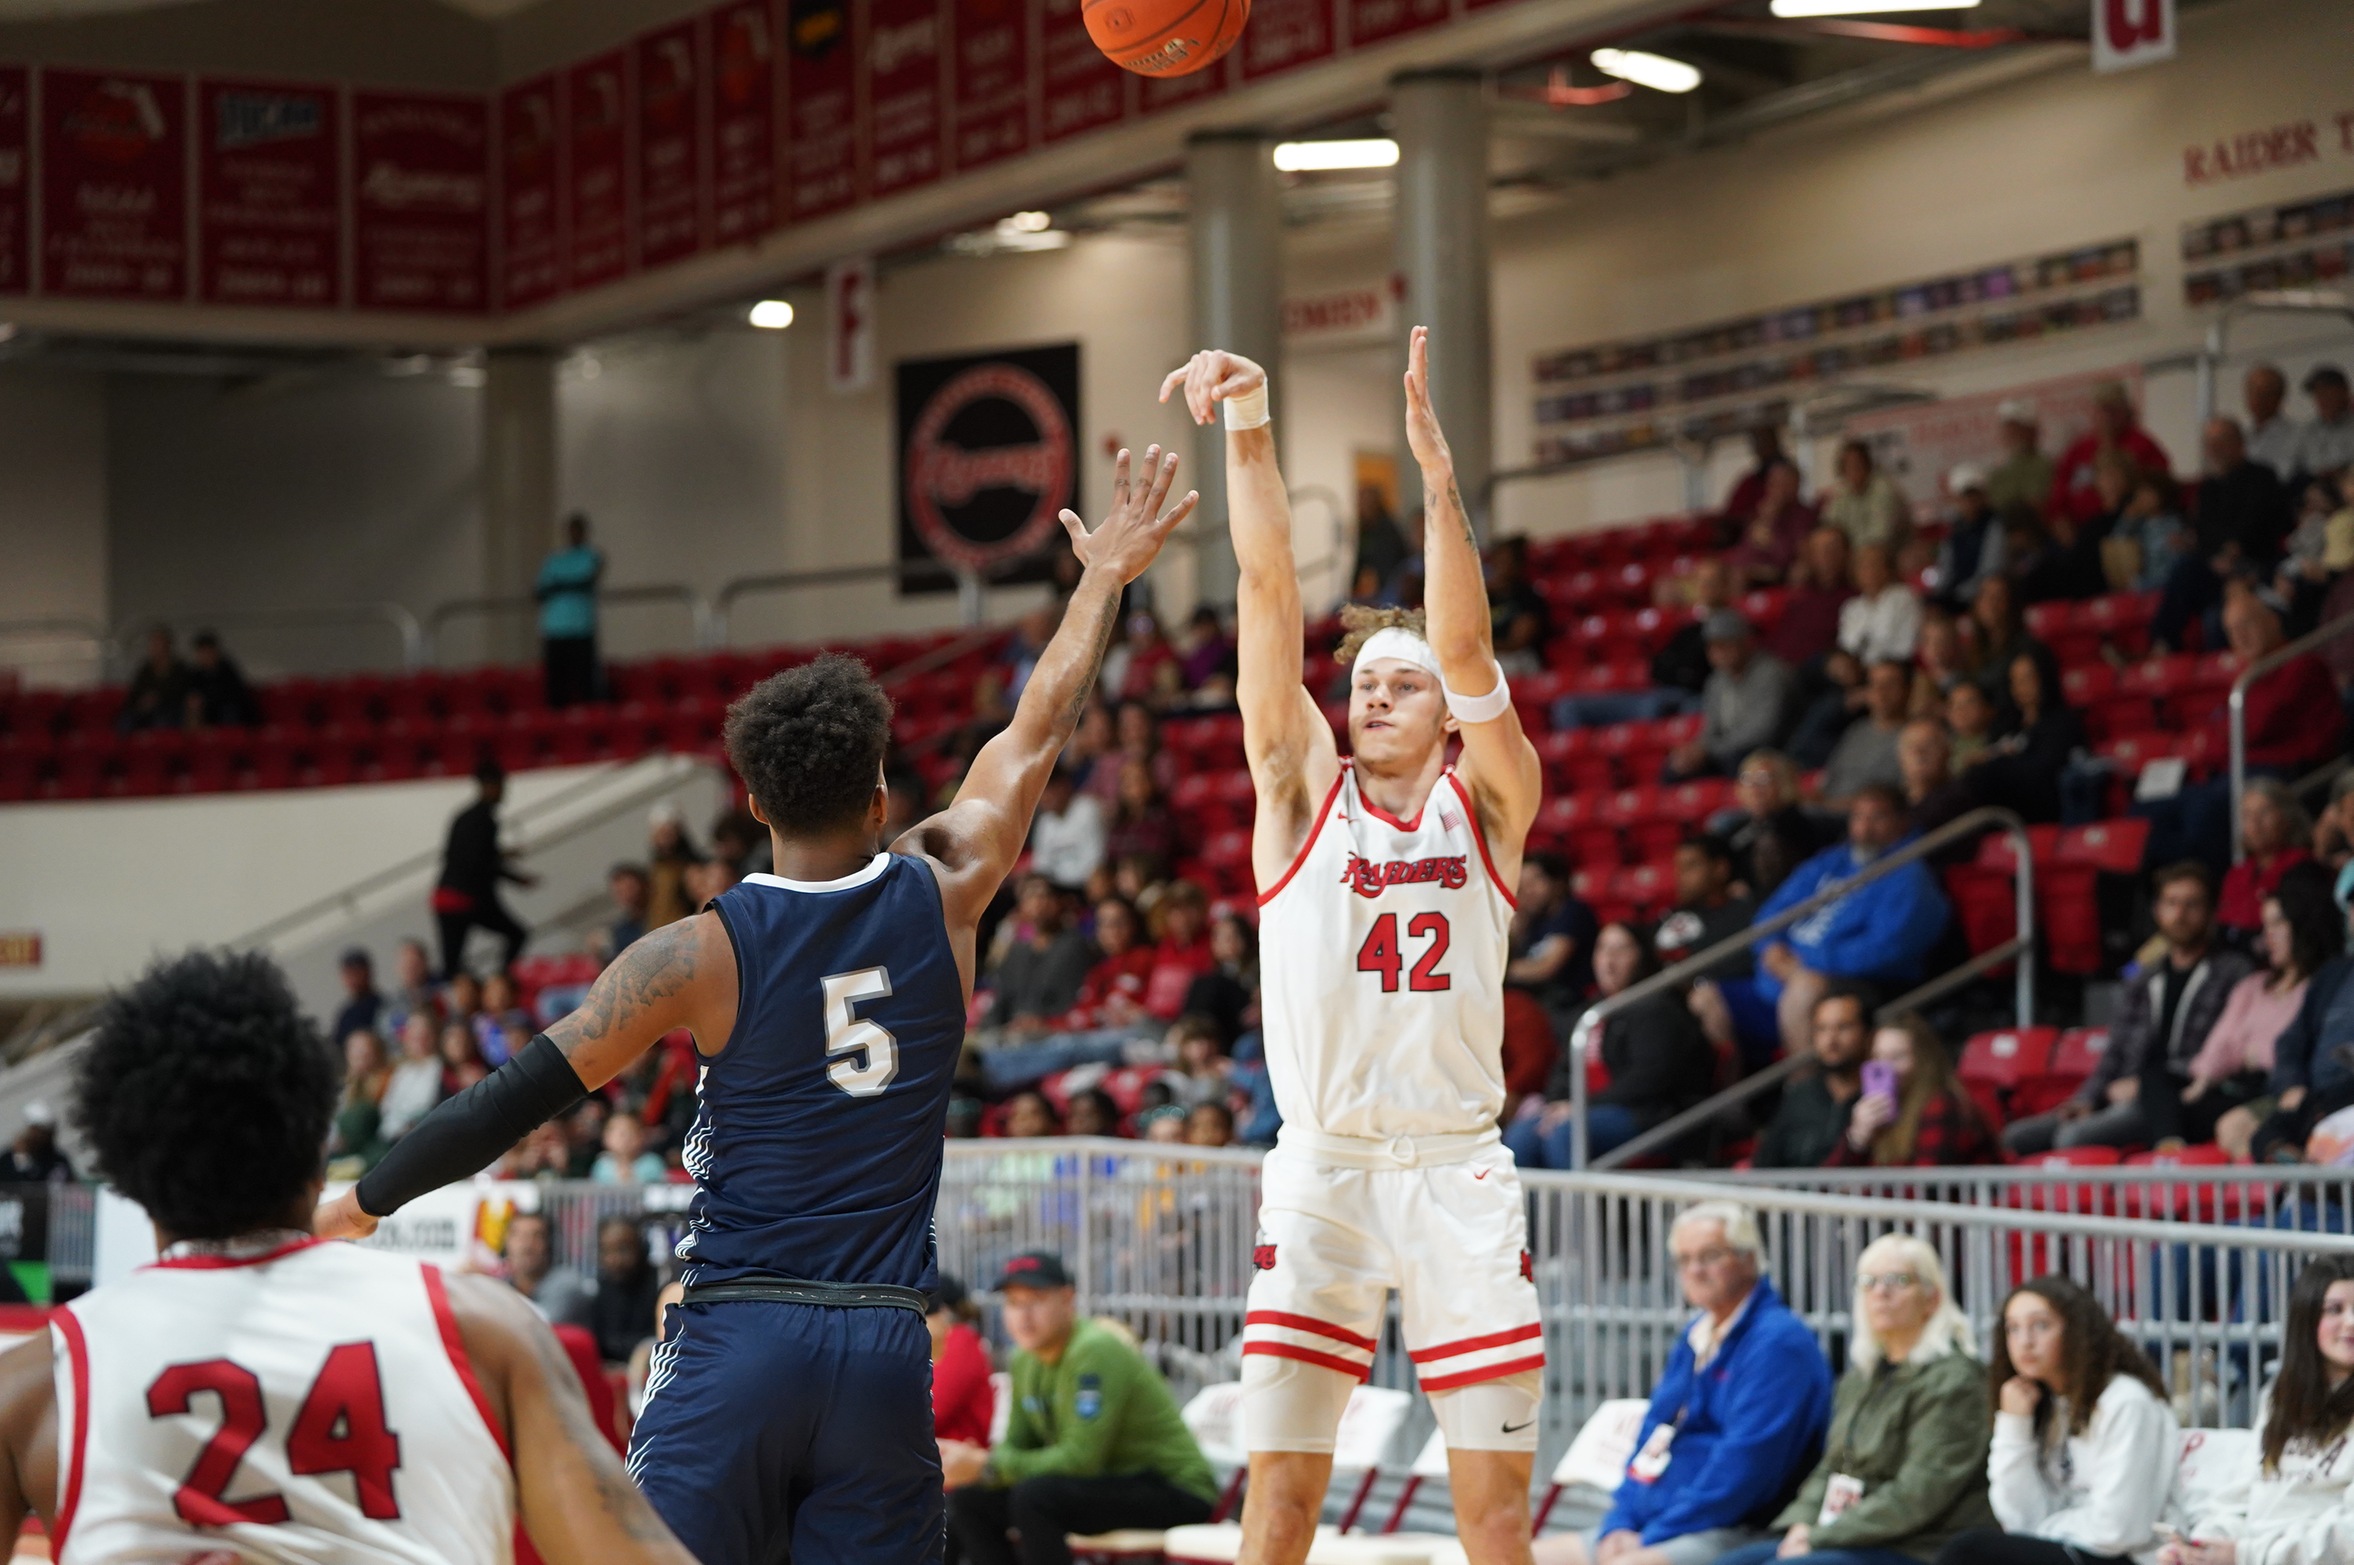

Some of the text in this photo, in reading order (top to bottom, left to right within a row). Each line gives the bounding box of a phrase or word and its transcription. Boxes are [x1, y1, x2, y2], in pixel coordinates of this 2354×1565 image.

[1340, 851, 1468, 898] RAIDERS
[1357, 911, 1451, 993] 42
[819, 965, 900, 1098] 5
[146, 1339, 402, 1525] 24
